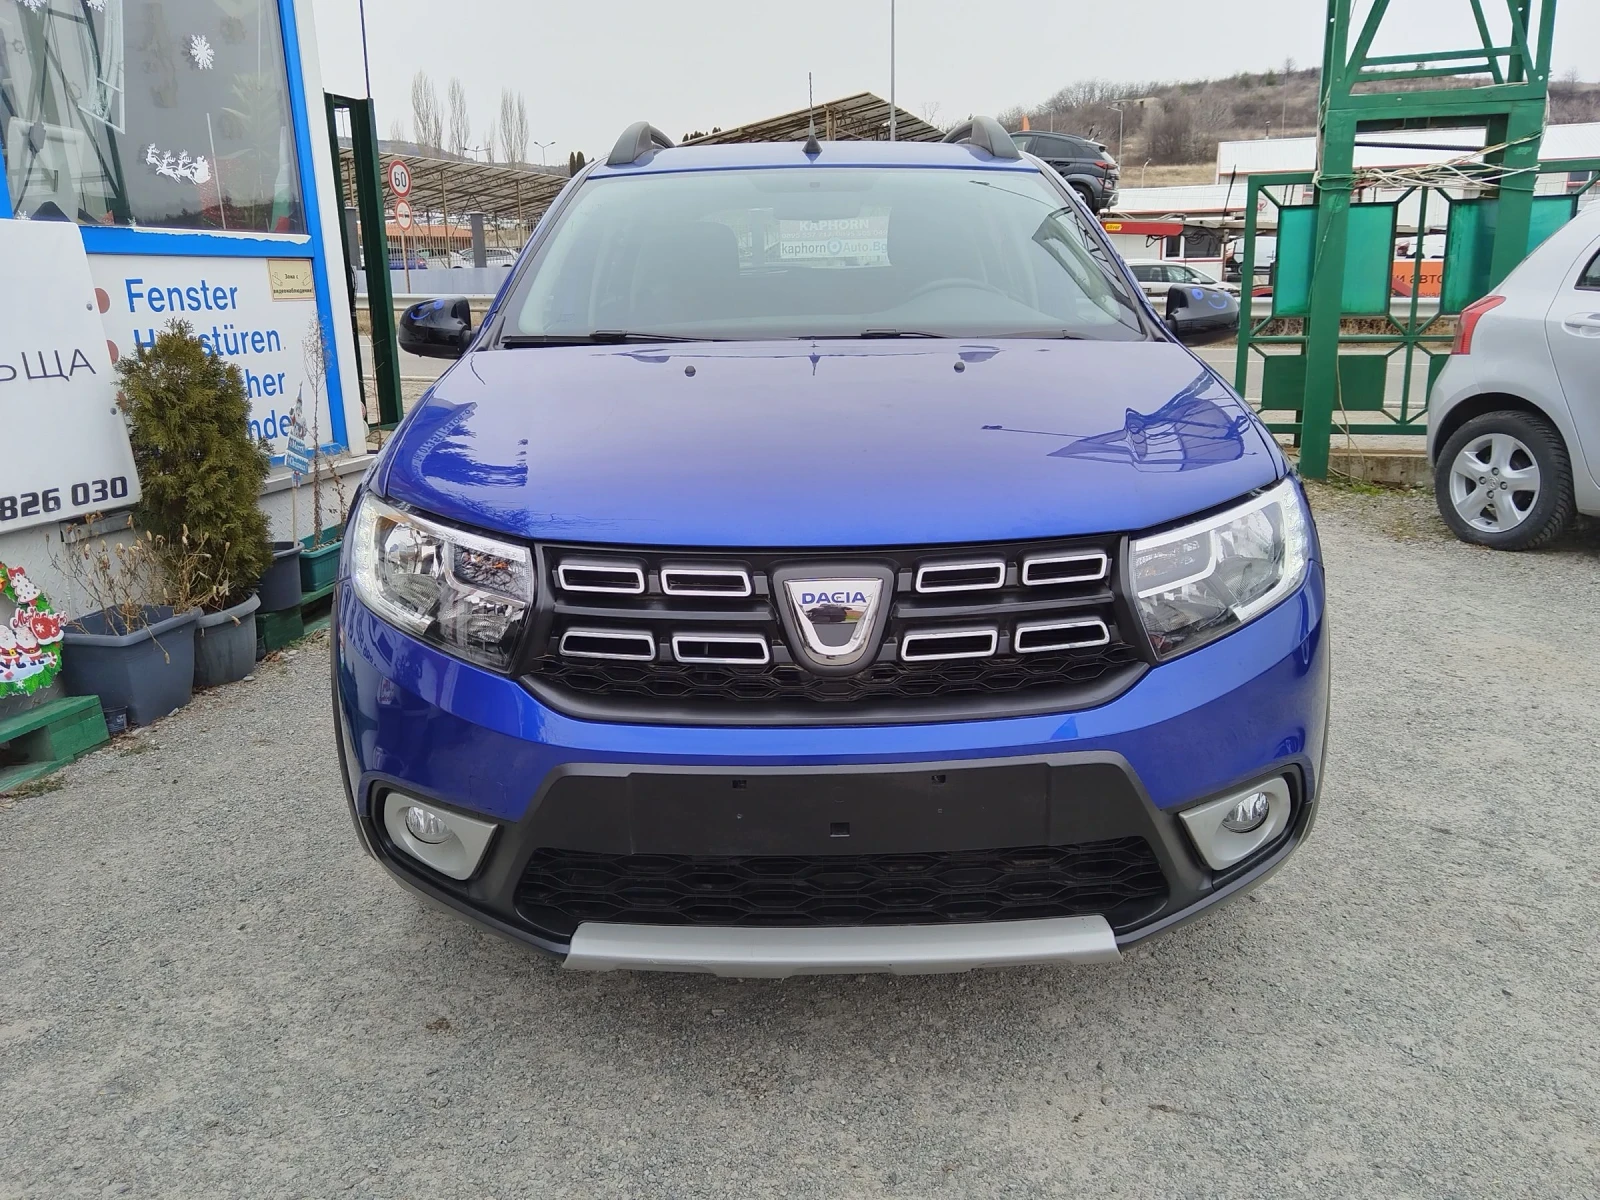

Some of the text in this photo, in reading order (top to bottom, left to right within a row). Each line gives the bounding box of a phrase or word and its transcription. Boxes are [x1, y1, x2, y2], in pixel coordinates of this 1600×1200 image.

[394, 171, 407, 188] 60
[799, 219, 869, 231] KAPHORN
[781, 243, 826, 256] kaphorn
[125, 278, 238, 313] Fenster
[133, 324, 281, 362] Hstüren
[0, 475, 128, 521] 826 030
[801, 591, 867, 605] DACIA
